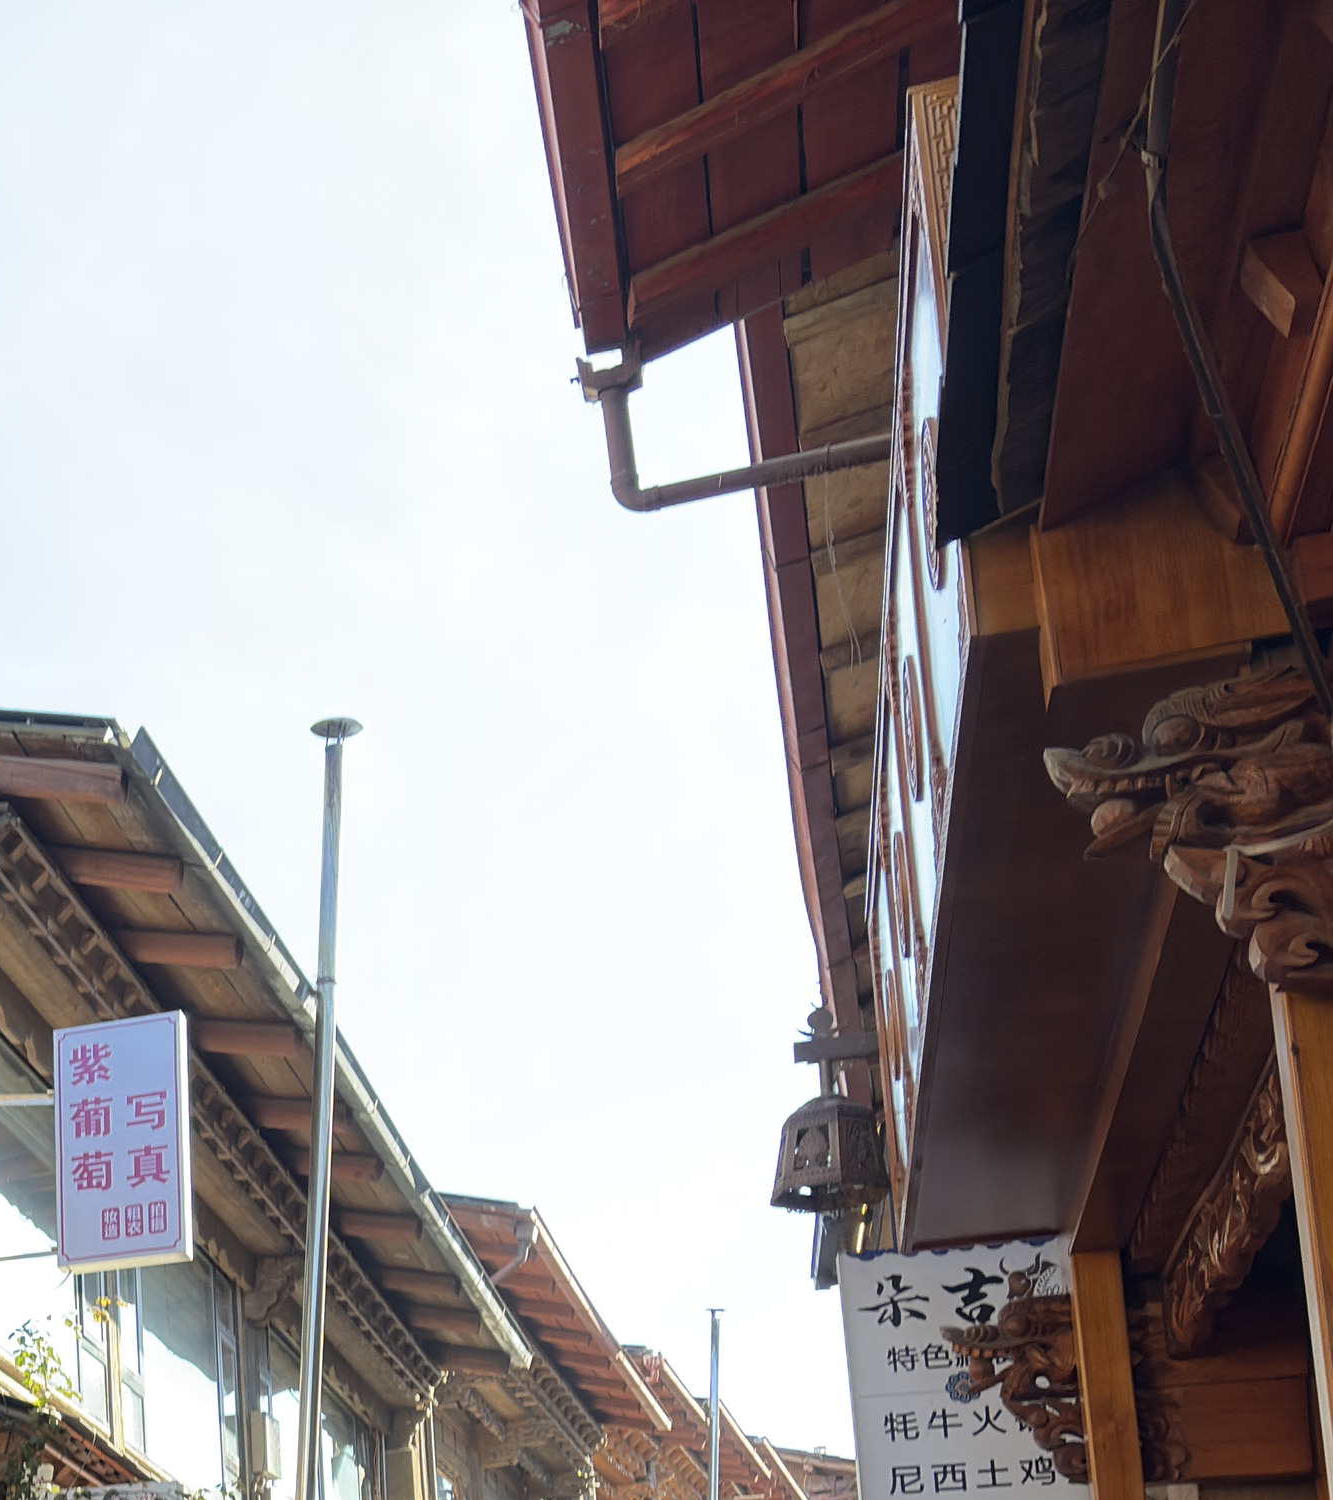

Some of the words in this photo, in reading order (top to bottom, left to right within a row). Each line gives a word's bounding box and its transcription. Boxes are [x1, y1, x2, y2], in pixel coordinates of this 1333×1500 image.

[69, 1042, 114, 1192] 紫葡萄
[126, 1090, 170, 1187] 写真
[858, 1267, 1004, 1328] 朵吉
[887, 1343, 1012, 1373] 特色
[884, 1405, 1032, 1442] 牦牛火
[890, 1456, 1057, 1495] 尼西土鸡
